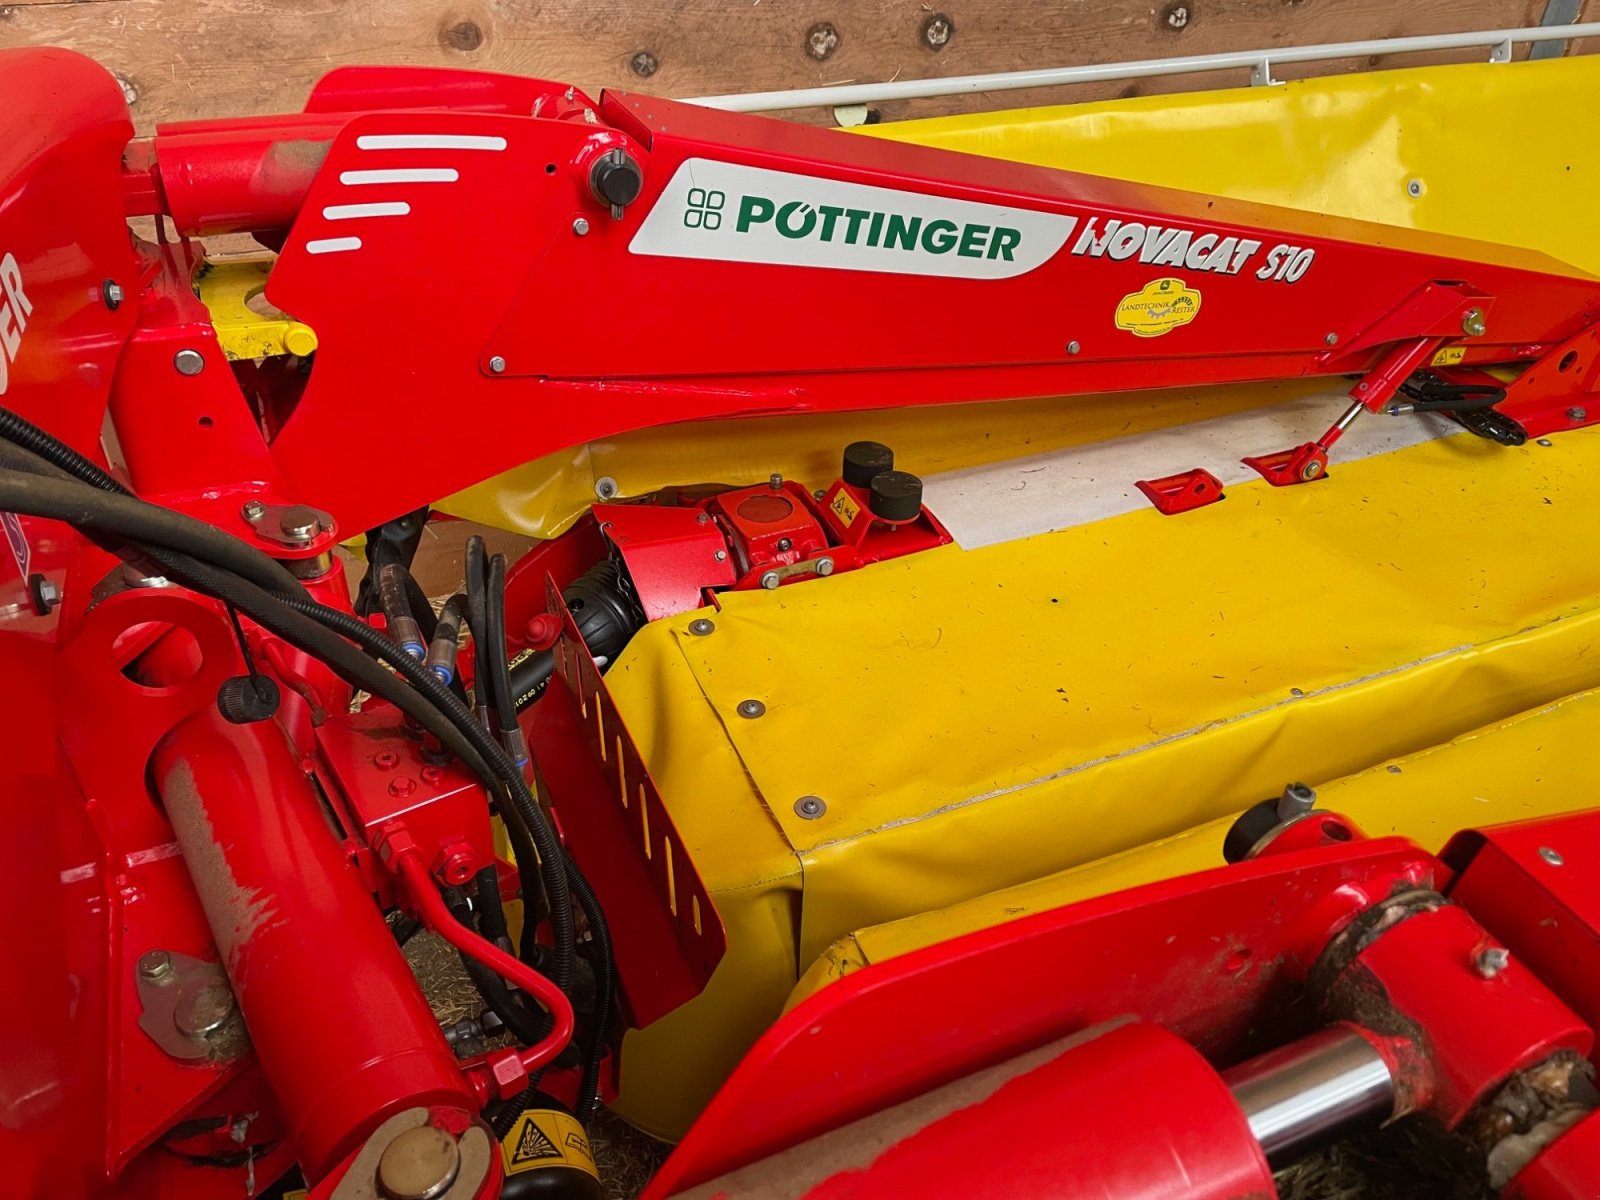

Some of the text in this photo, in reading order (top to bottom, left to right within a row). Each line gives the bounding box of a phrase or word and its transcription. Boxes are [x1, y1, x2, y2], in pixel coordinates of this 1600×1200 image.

[736, 195, 1022, 261] PÖTTINGER
[1072, 216, 1316, 284] NOVACAT S10
[0, 252, 33, 395] ER
[1121, 301, 1171, 312] LANDTECHNIK
